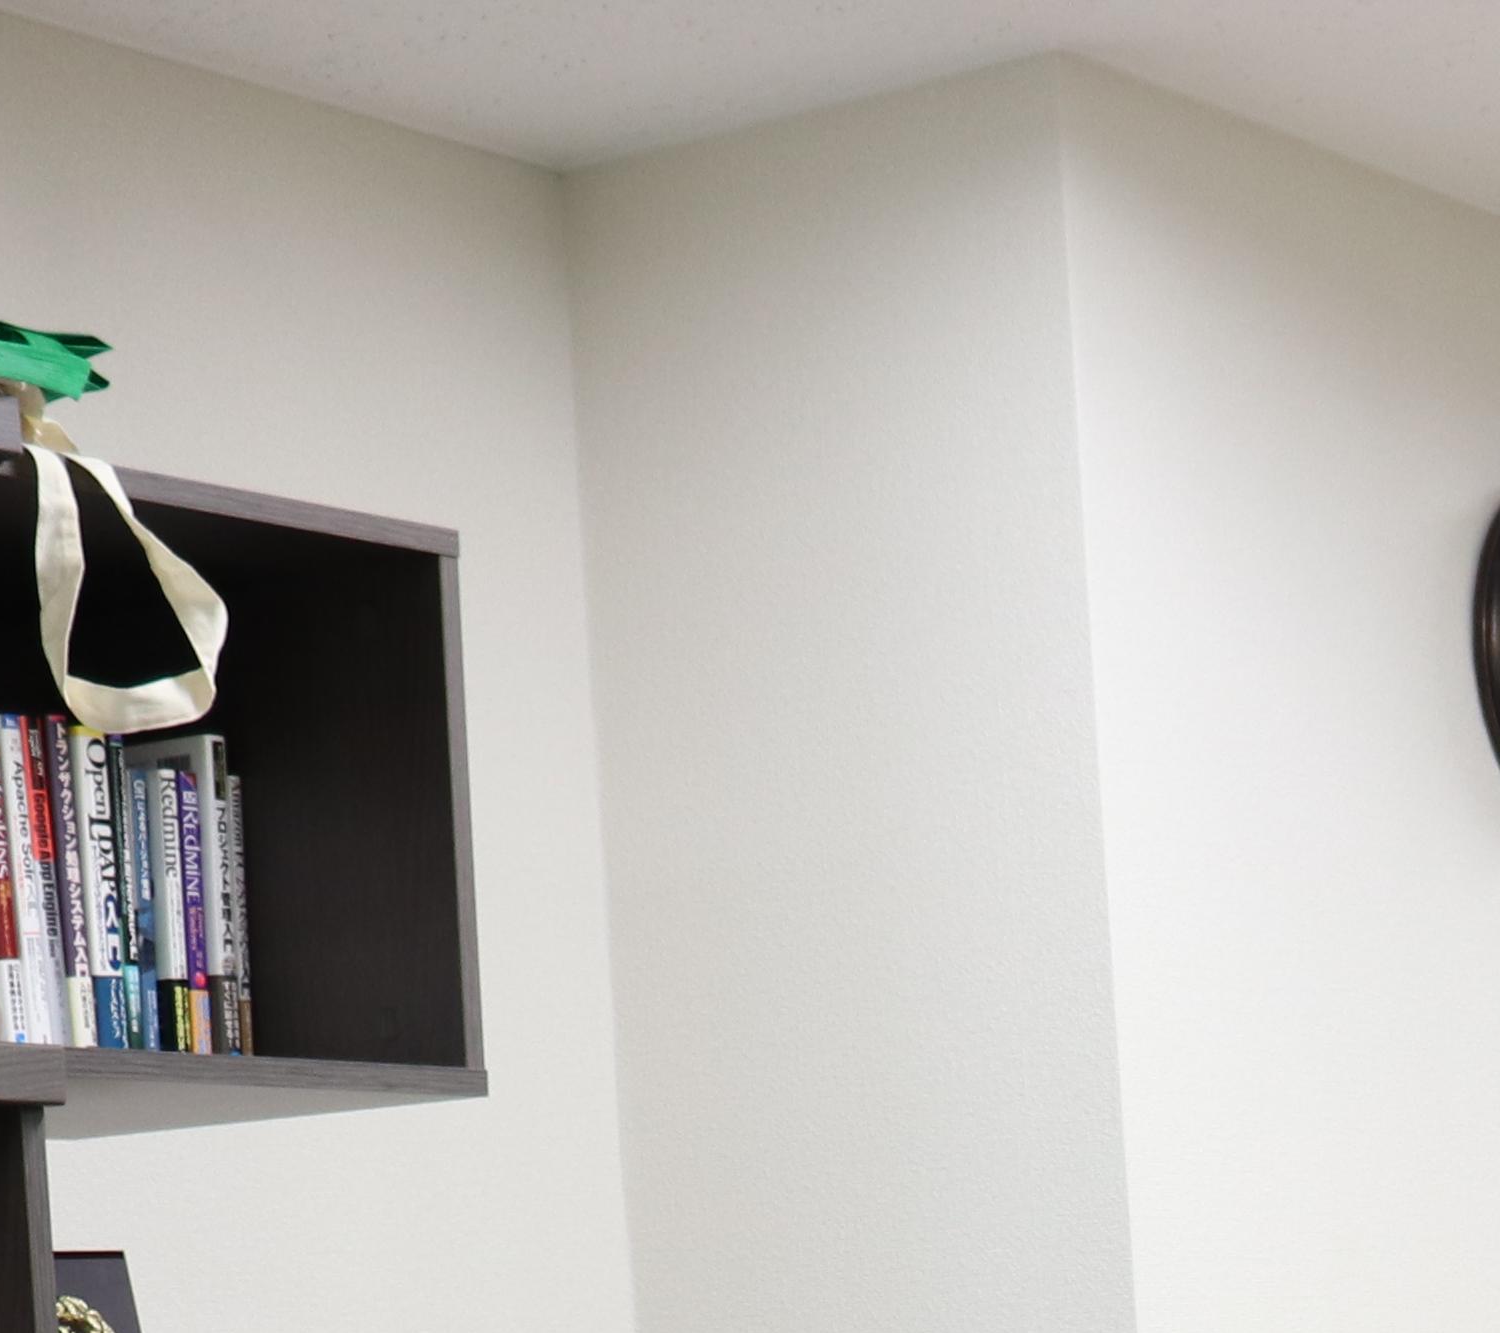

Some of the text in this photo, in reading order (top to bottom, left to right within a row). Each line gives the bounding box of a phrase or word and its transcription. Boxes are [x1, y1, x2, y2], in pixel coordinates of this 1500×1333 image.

[12, 760, 29, 839] Apache
[160, 777, 179, 879] Redmine
[55, 722, 90, 977] トランザクション処理システム入門
[41, 882, 60, 937] Engine
